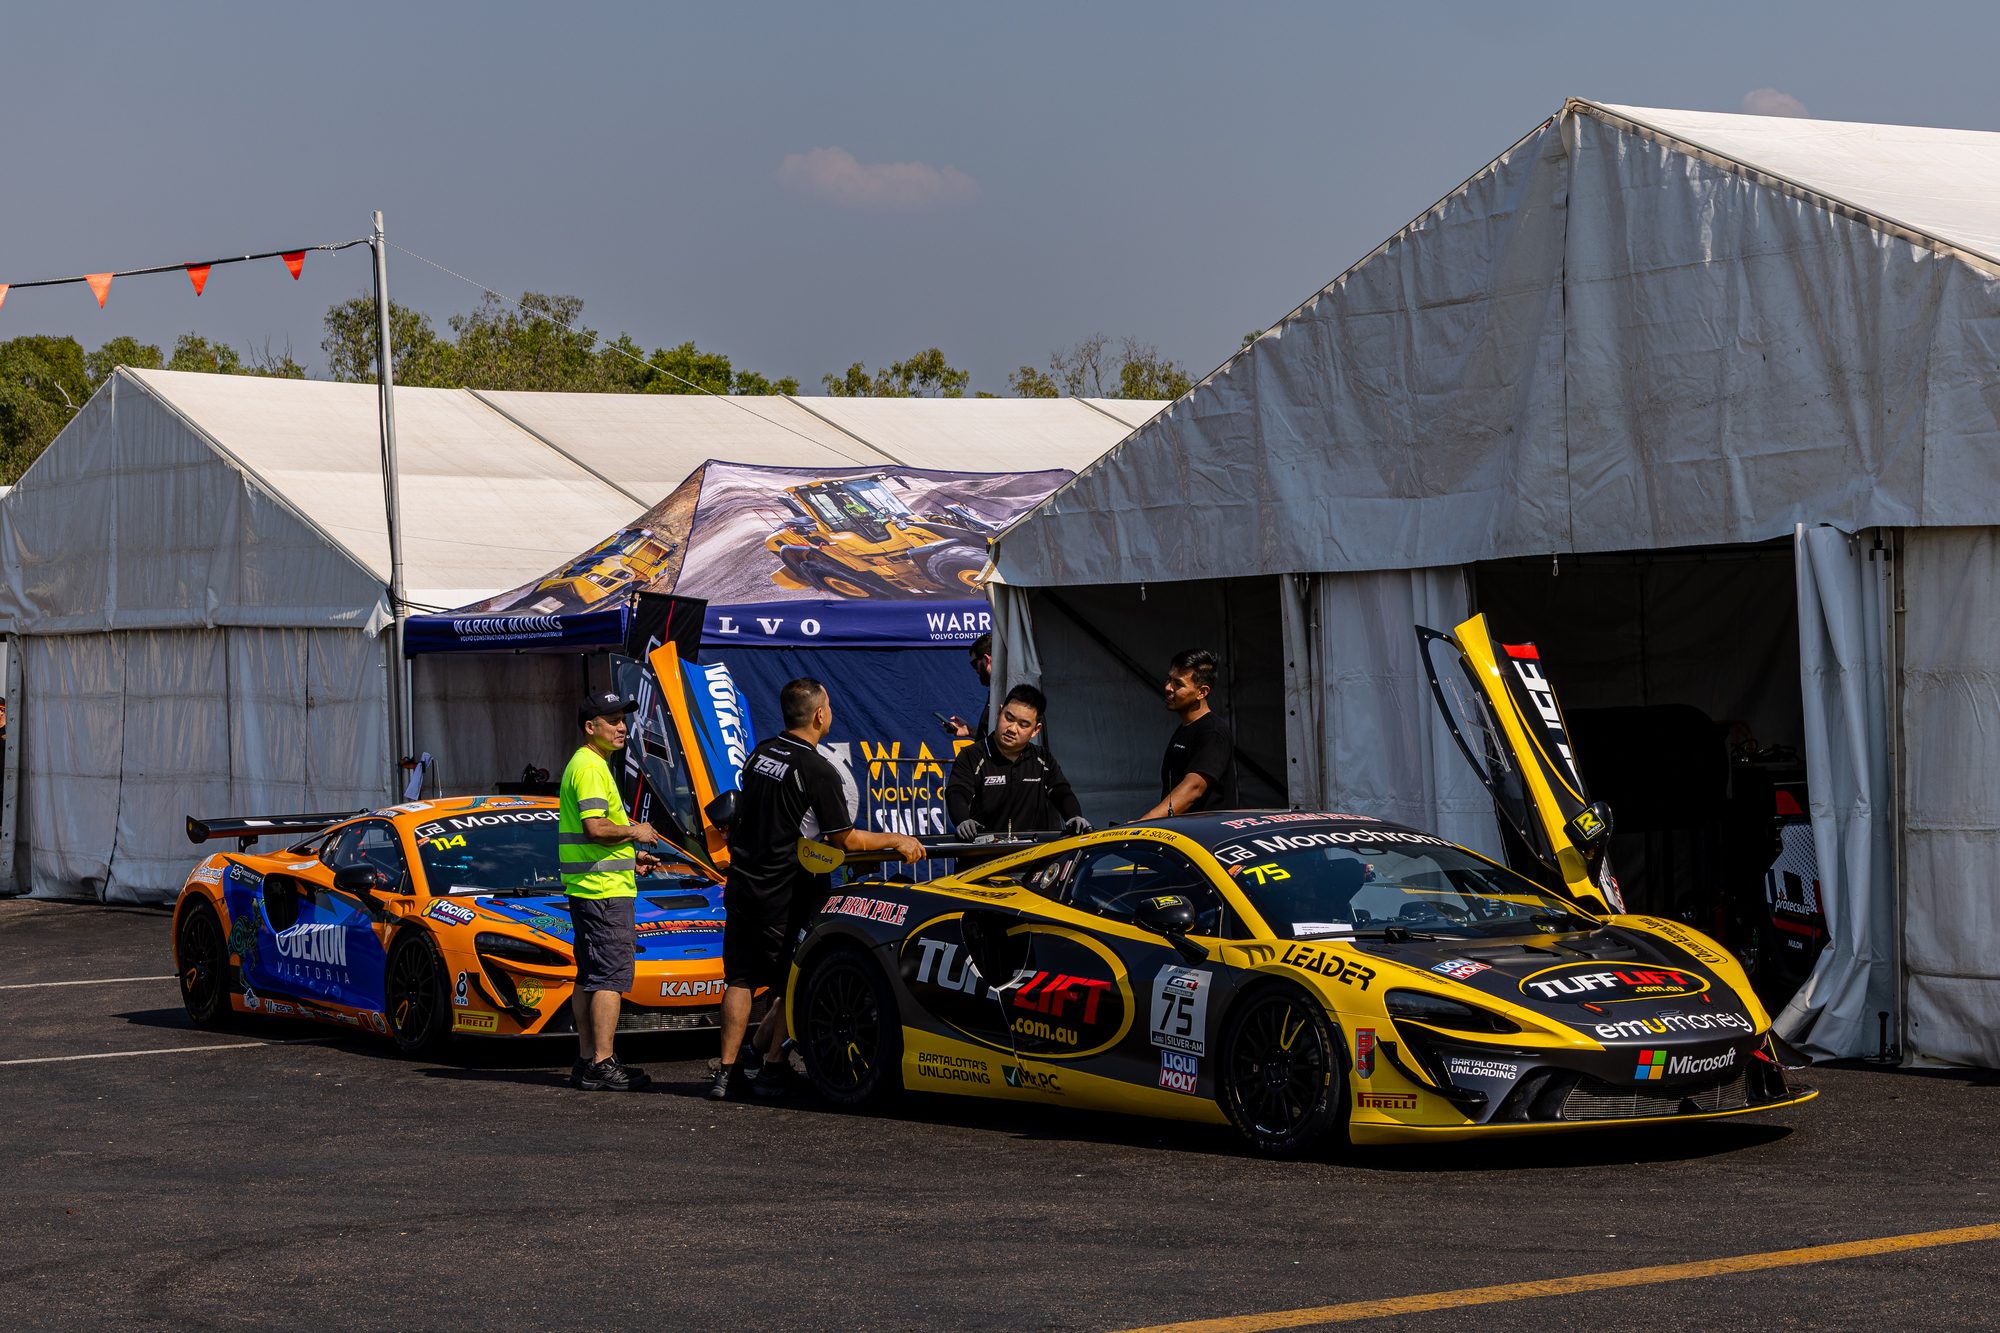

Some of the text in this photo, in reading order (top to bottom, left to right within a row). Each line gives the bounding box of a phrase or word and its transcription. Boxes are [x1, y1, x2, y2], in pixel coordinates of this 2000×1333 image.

[453, 615, 563, 635] WARRIN MINING
[753, 754, 789, 780] TSM
[984, 775, 1006, 784] TSM
[430, 834, 467, 851] 114
[1150, 830, 1178, 842] SOUTAR
[809, 850, 833, 865] Shell Card
[1242, 863, 1292, 885] 75
[437, 900, 475, 921] Pacific
[837, 896, 876, 918] BRM
[869, 900, 909, 926] PILE
[1775, 899, 1810, 916] protecsure
[430, 911, 457, 925] fuel solutions
[291, 923, 347, 967] DEXION
[277, 961, 350, 985] VICTORIA
[1280, 944, 1377, 992] LEADER
[456, 971, 468, 998] 8
[661, 979, 728, 997] KAPIT
[1529, 971, 1689, 998] TUFFLIFT
[1635, 985, 1685, 994] .com.au
[458, 1013, 494, 1028] PIRELLI
[1159, 992, 1195, 1037] 75
[1010, 1017, 1078, 1045] .com.au
[1595, 1012, 1753, 1039] emumoney
[1166, 1035, 1203, 1052] SILVER-AM
[918, 1052, 988, 1071] BARTALOTTA'S
[1163, 1052, 1196, 1074] LIQUI
[1452, 1057, 1518, 1072] BARTALOTTA'S
[1668, 1047, 1736, 1075] Microsoft
[918, 1064, 991, 1084] UNLOADING
[1161, 1071, 1197, 1093] MOLY
[1451, 1065, 1516, 1080] UNLOADING
[1357, 1092, 1418, 1110] PIRELLI
